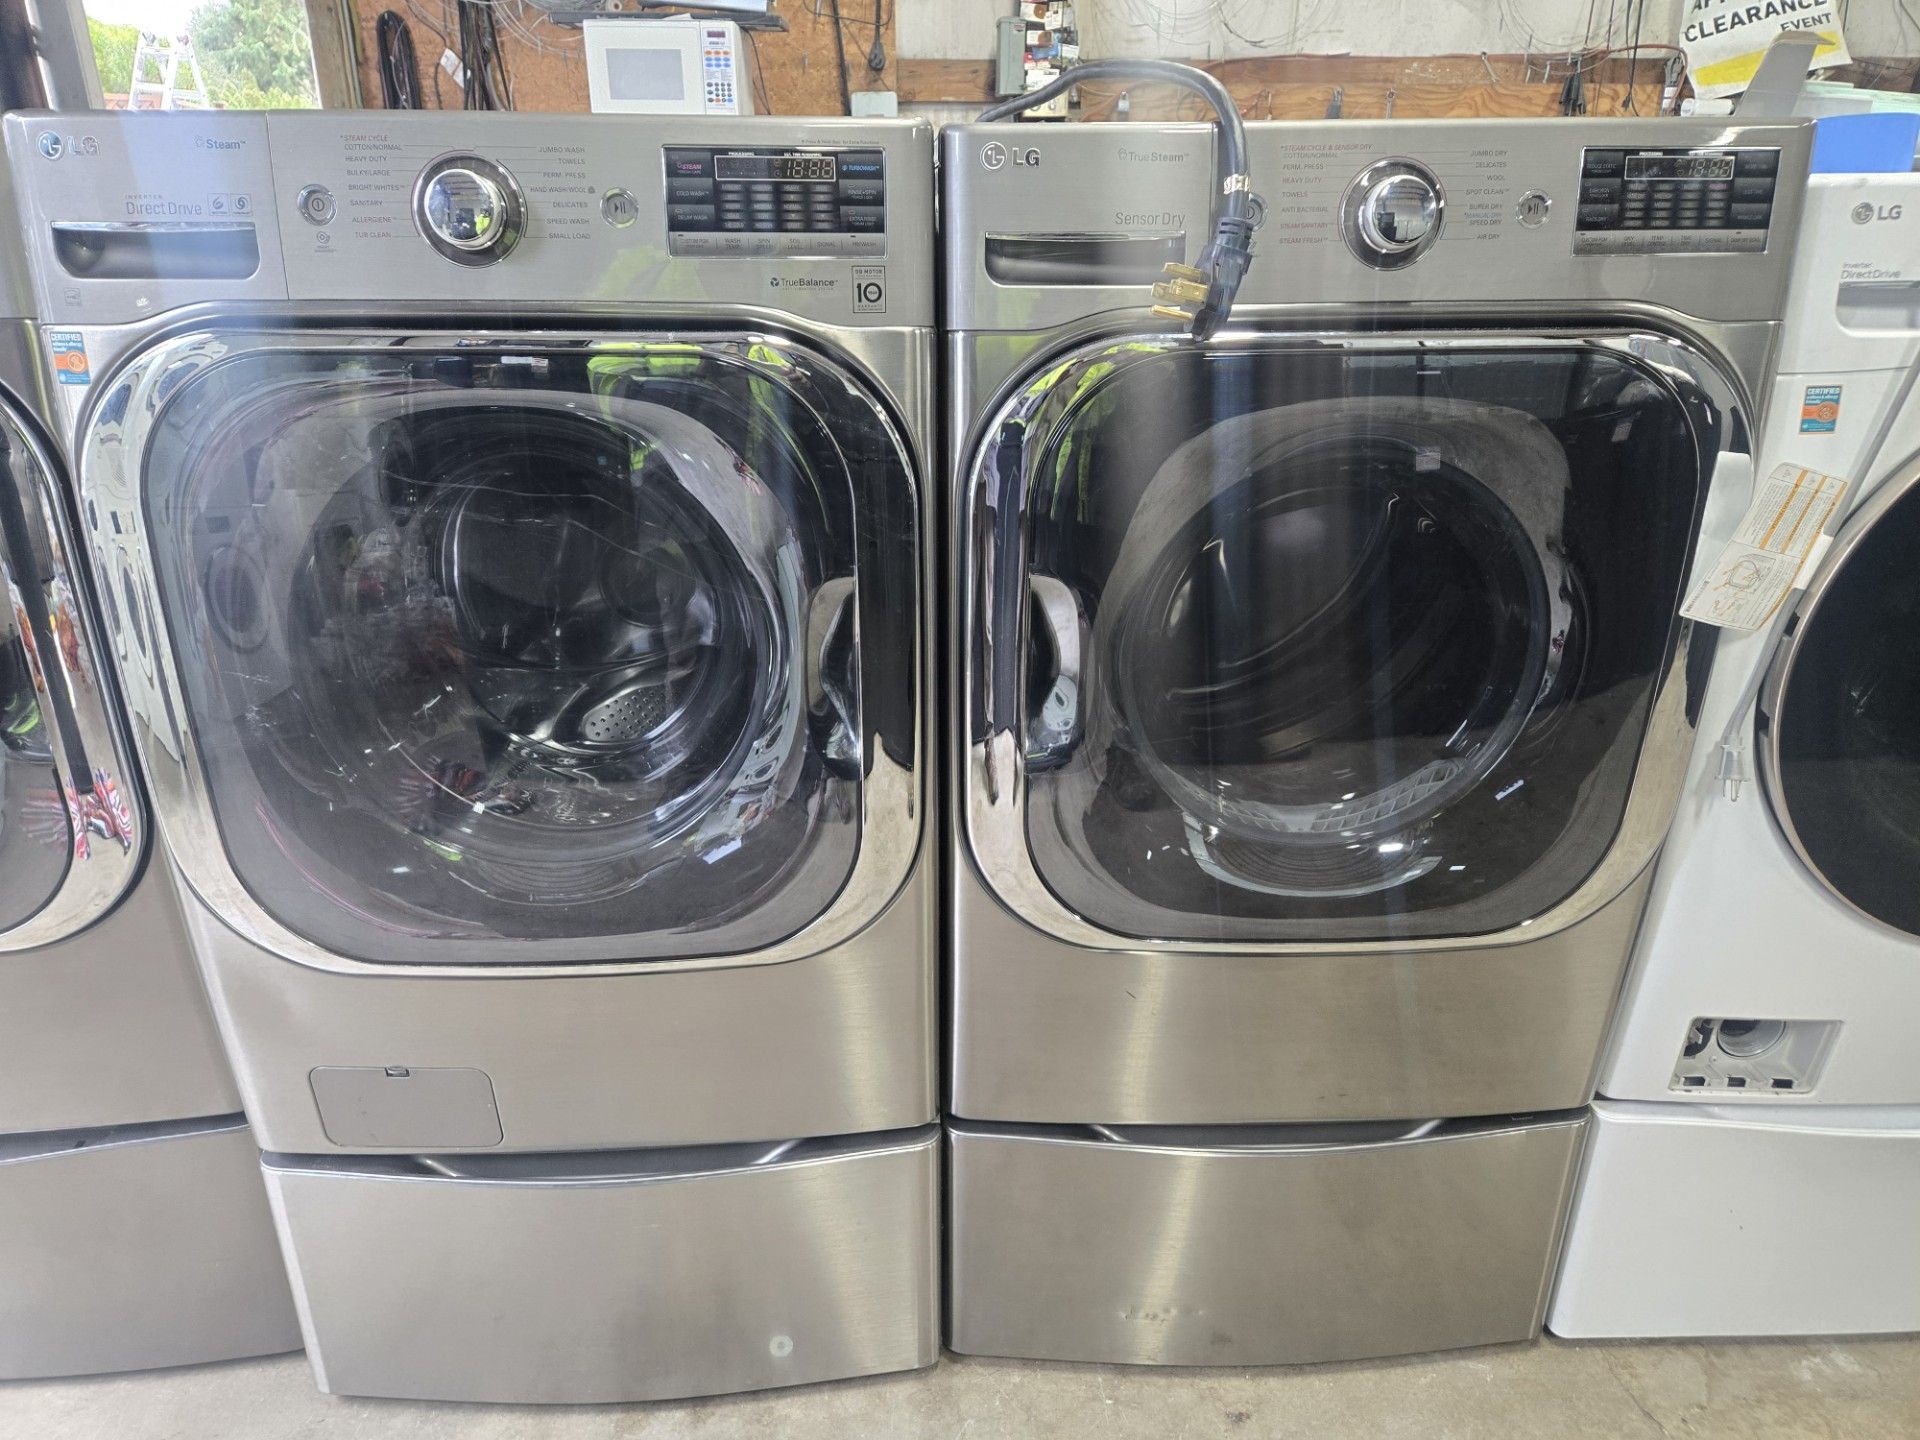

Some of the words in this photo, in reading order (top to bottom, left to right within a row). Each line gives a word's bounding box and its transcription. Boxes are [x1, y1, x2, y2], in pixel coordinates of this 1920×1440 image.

[1780, 12, 1832, 32] EVENT
[67, 136, 101, 155] LG
[1012, 148, 1041, 167] LG
[1115, 212, 1160, 226] Sensor
[1162, 212, 1186, 228] Dry
[1877, 204, 1903, 221] LG
[856, 282, 882, 303] 10
